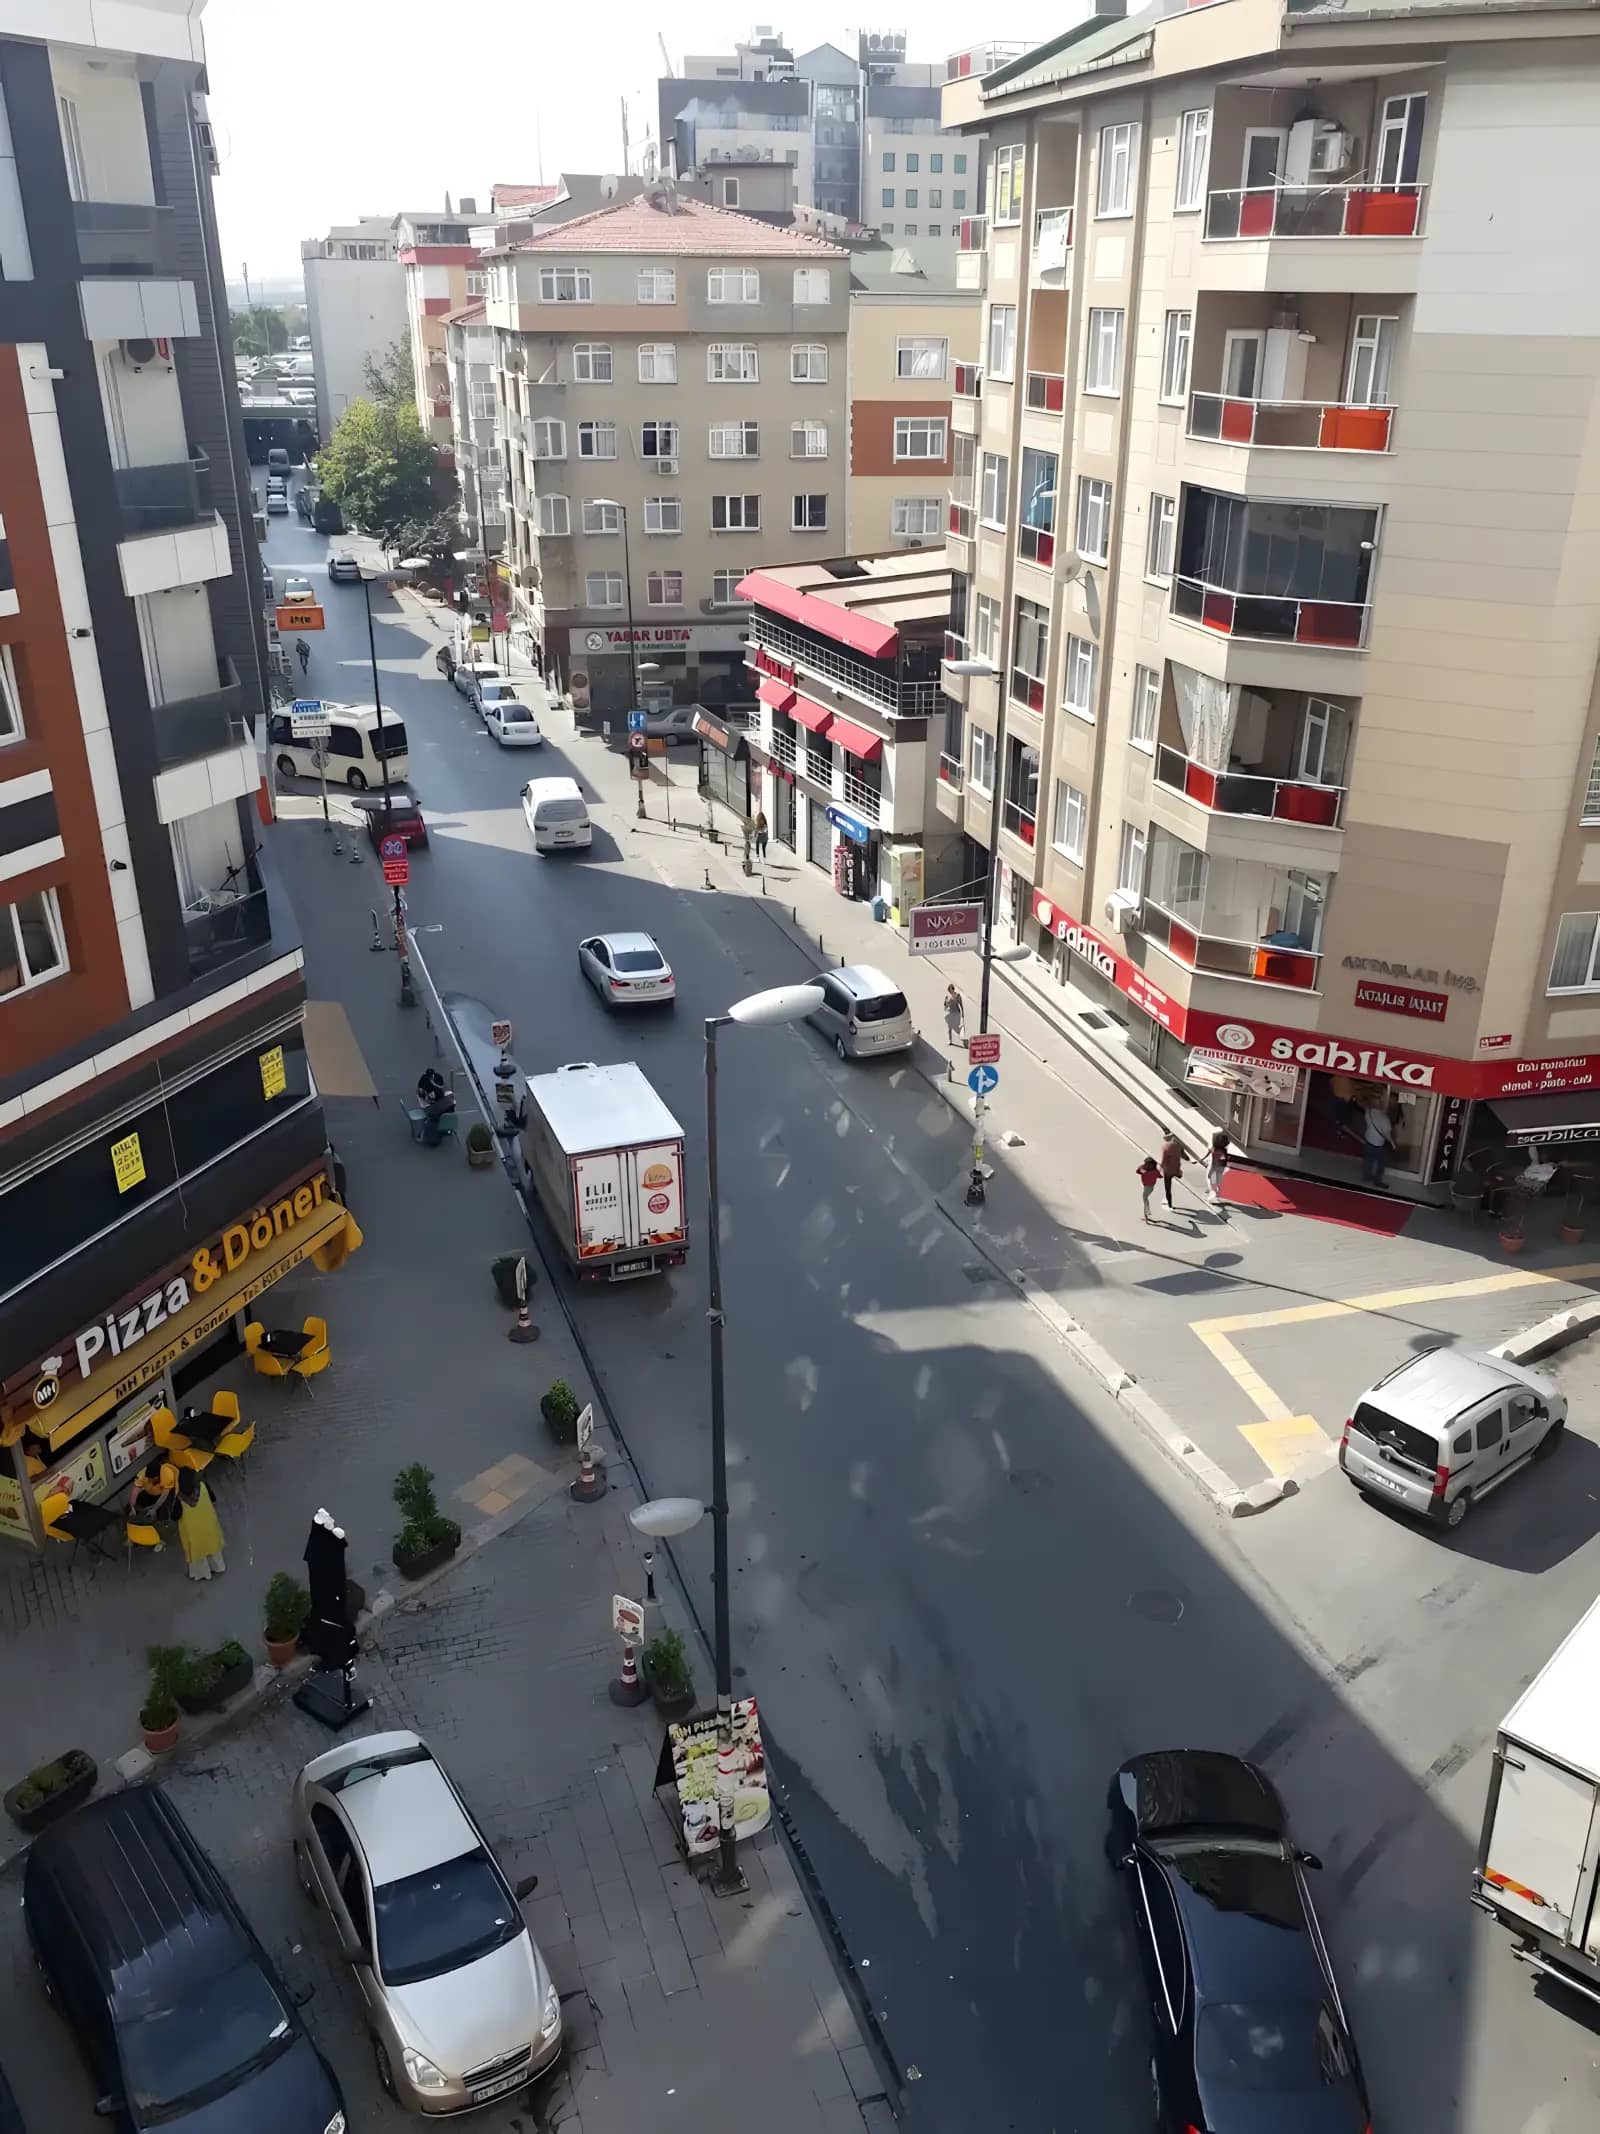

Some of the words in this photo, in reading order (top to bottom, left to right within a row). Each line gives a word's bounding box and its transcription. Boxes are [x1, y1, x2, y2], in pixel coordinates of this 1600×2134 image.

[75, 1276, 190, 1379] Pizza
[191, 1248, 222, 1293] &
[222, 1174, 331, 1273] Döner
